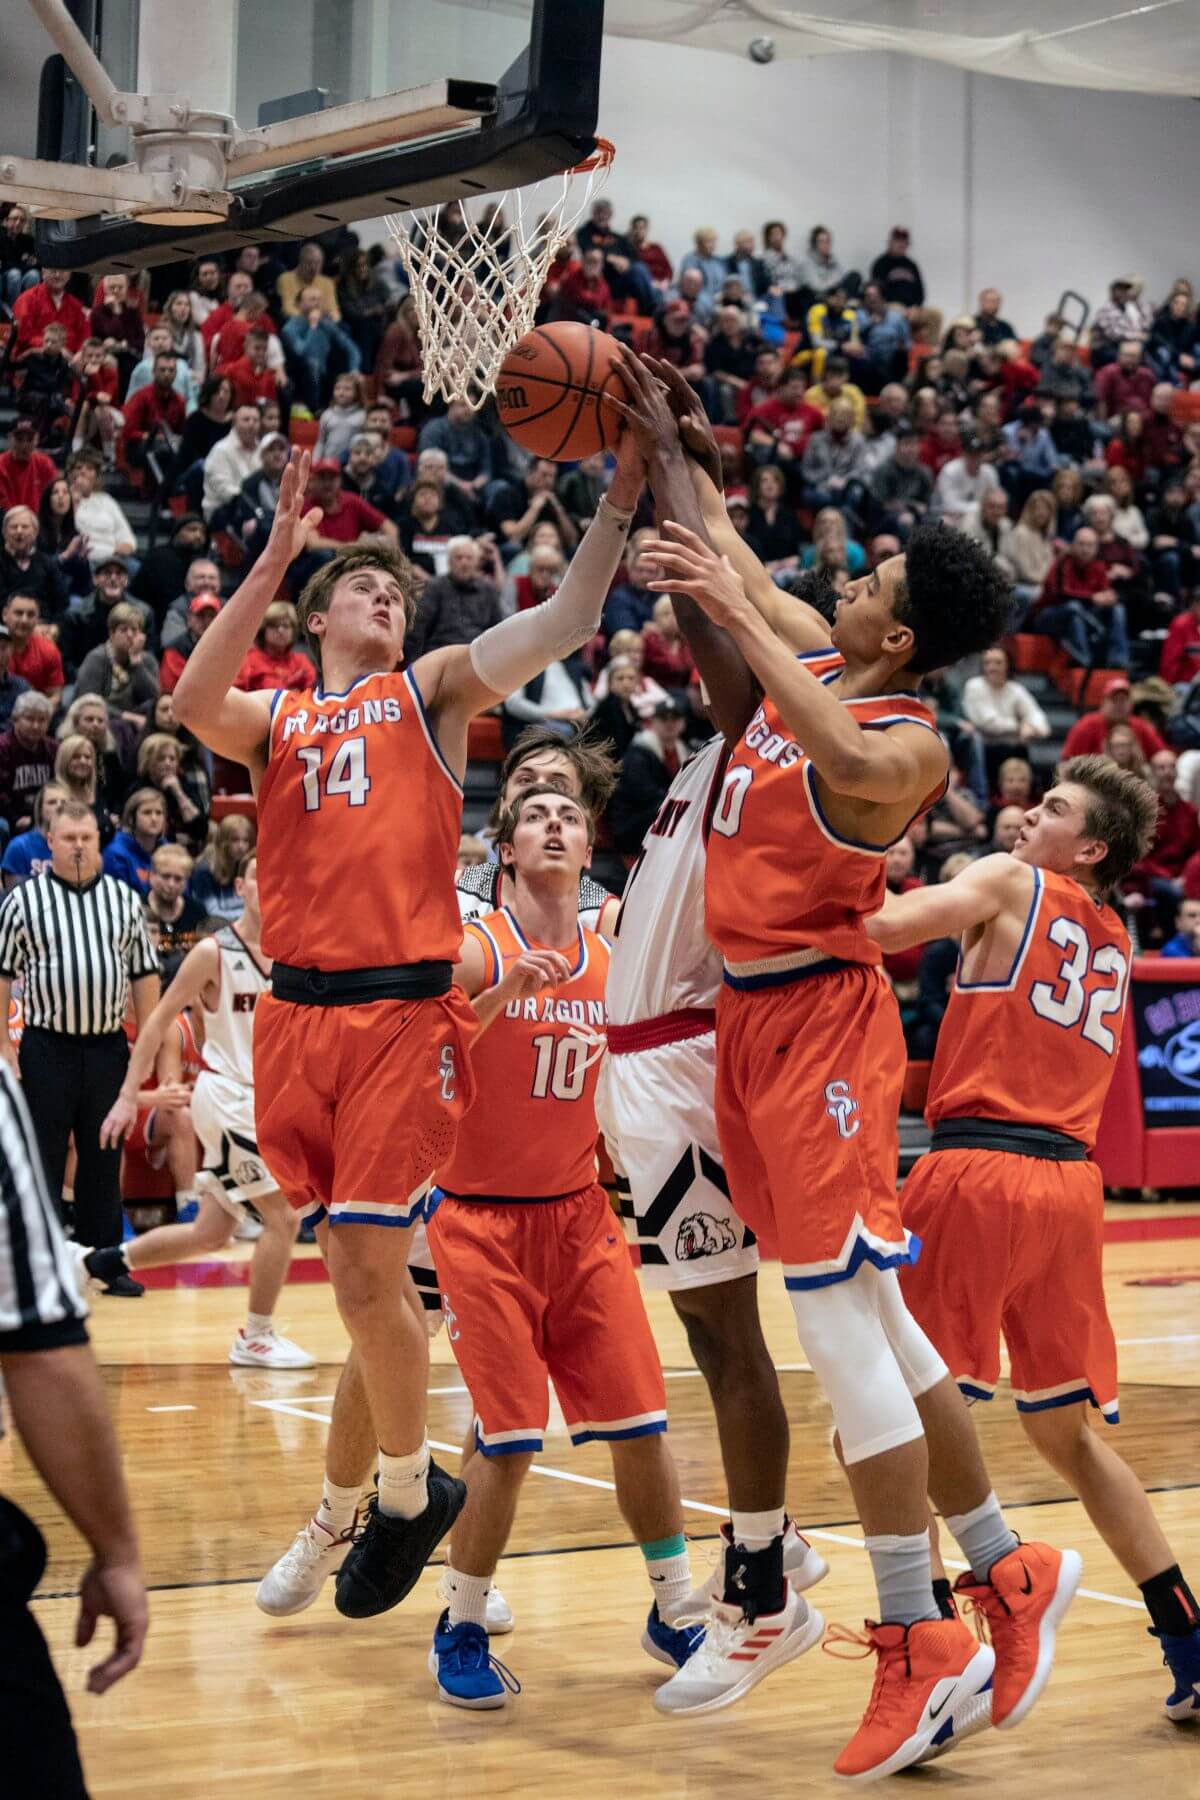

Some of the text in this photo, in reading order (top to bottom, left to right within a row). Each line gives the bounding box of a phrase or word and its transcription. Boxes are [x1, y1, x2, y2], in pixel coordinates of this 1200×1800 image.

[296, 736, 372, 813] 14
[505, 996, 610, 1026] DRAGON
[1028, 915, 1128, 1058] 32
[531, 1033, 588, 1101] 10
[824, 1079, 861, 1139] SC
